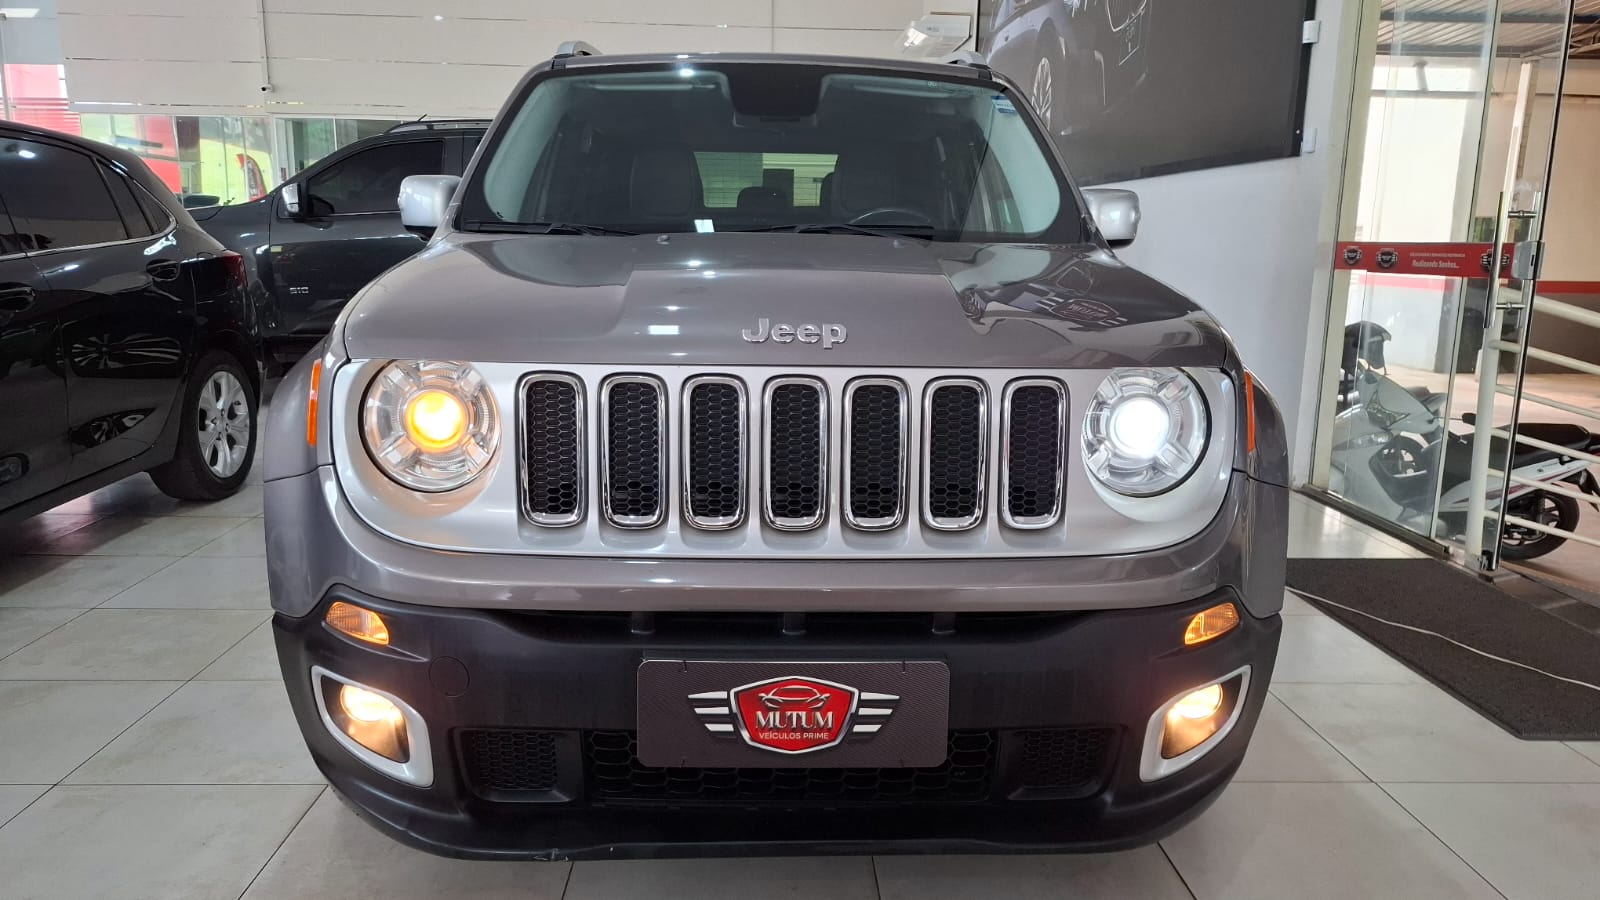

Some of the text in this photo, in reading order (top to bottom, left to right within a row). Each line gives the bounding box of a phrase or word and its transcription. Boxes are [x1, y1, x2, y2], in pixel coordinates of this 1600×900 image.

[742, 318, 847, 350] Jeep
[755, 711, 833, 729] MUTUM
[759, 731, 830, 740] VEÍCULOS PRIME
